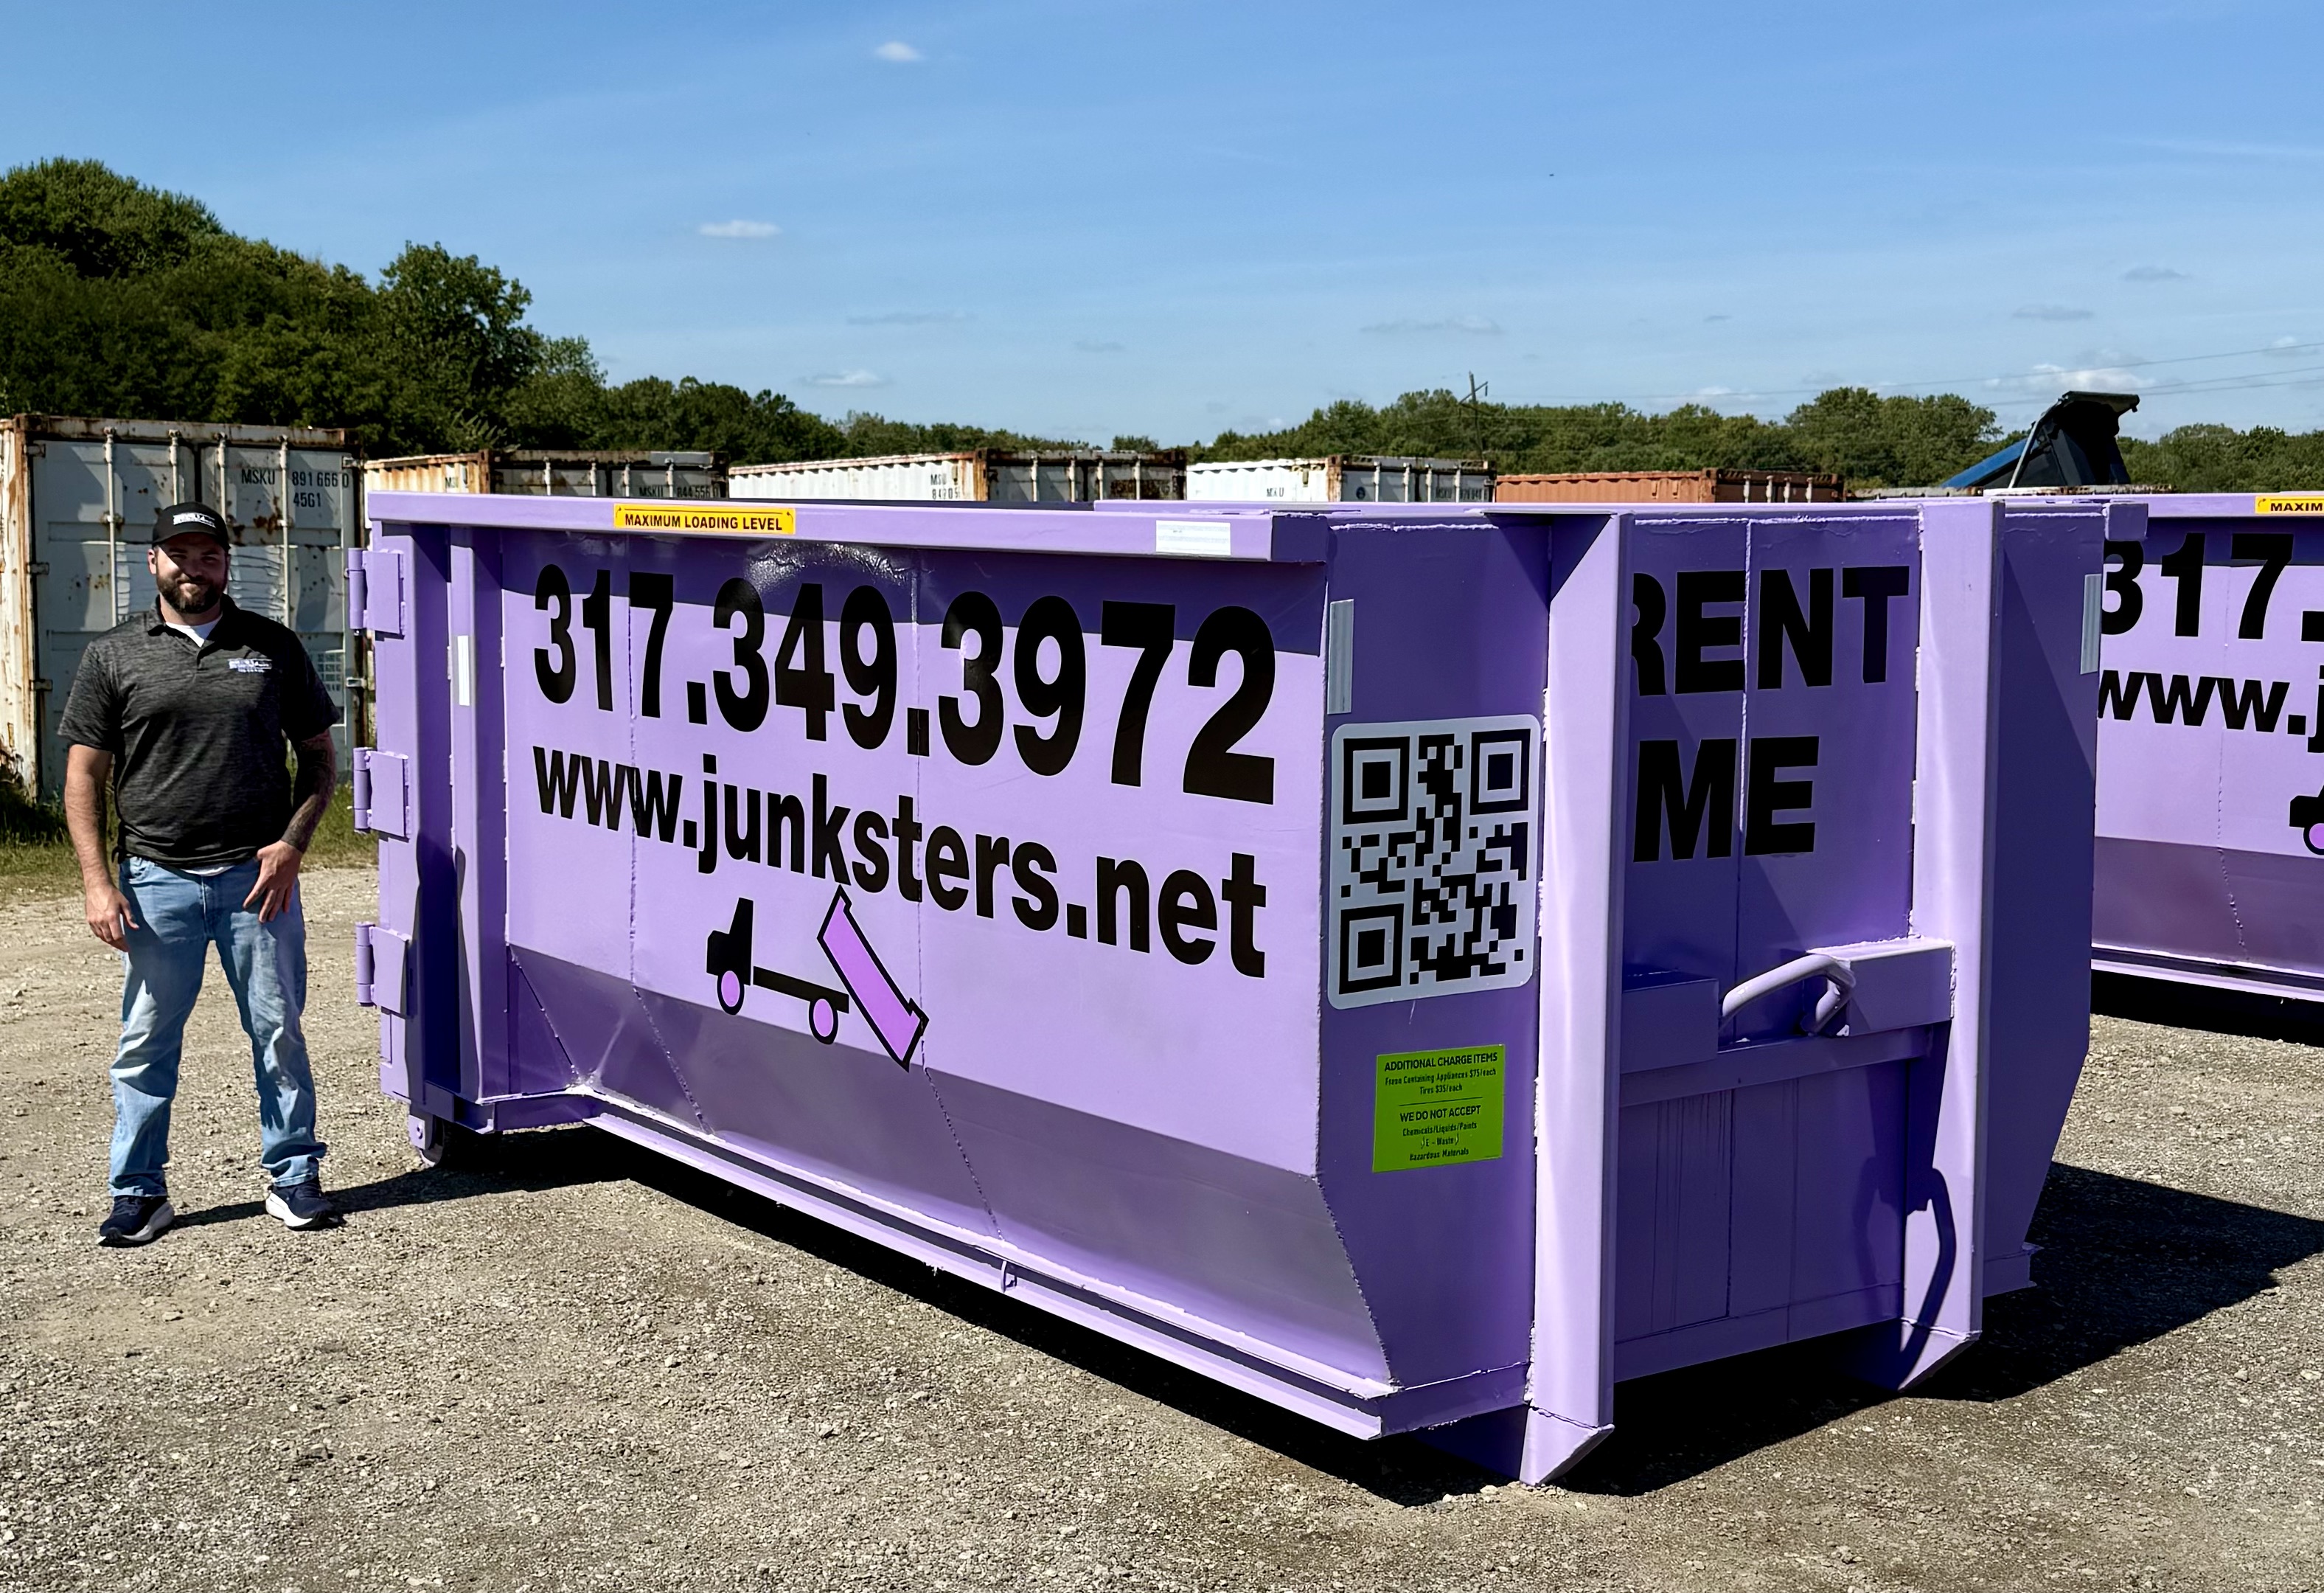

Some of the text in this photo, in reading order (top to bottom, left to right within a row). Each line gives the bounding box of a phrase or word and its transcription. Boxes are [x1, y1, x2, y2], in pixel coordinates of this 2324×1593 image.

[241, 468, 276, 485] MSKU
[292, 471, 313, 487] 891
[317, 472, 338, 487] 666
[625, 513, 782, 531] MAXIMUM LOADING LEVEL
[534, 563, 1276, 805] 317.349.3972
[1633, 735, 1820, 863] ME
[533, 746, 1267, 979] www.junksters.net
[1385, 1052, 1497, 1072] ADDITIONAL CHARGE ITEMS
[1420, 1086, 1433, 1094] Tires
[1399, 1104, 1481, 1122] WE DO NOT ACCEPT
